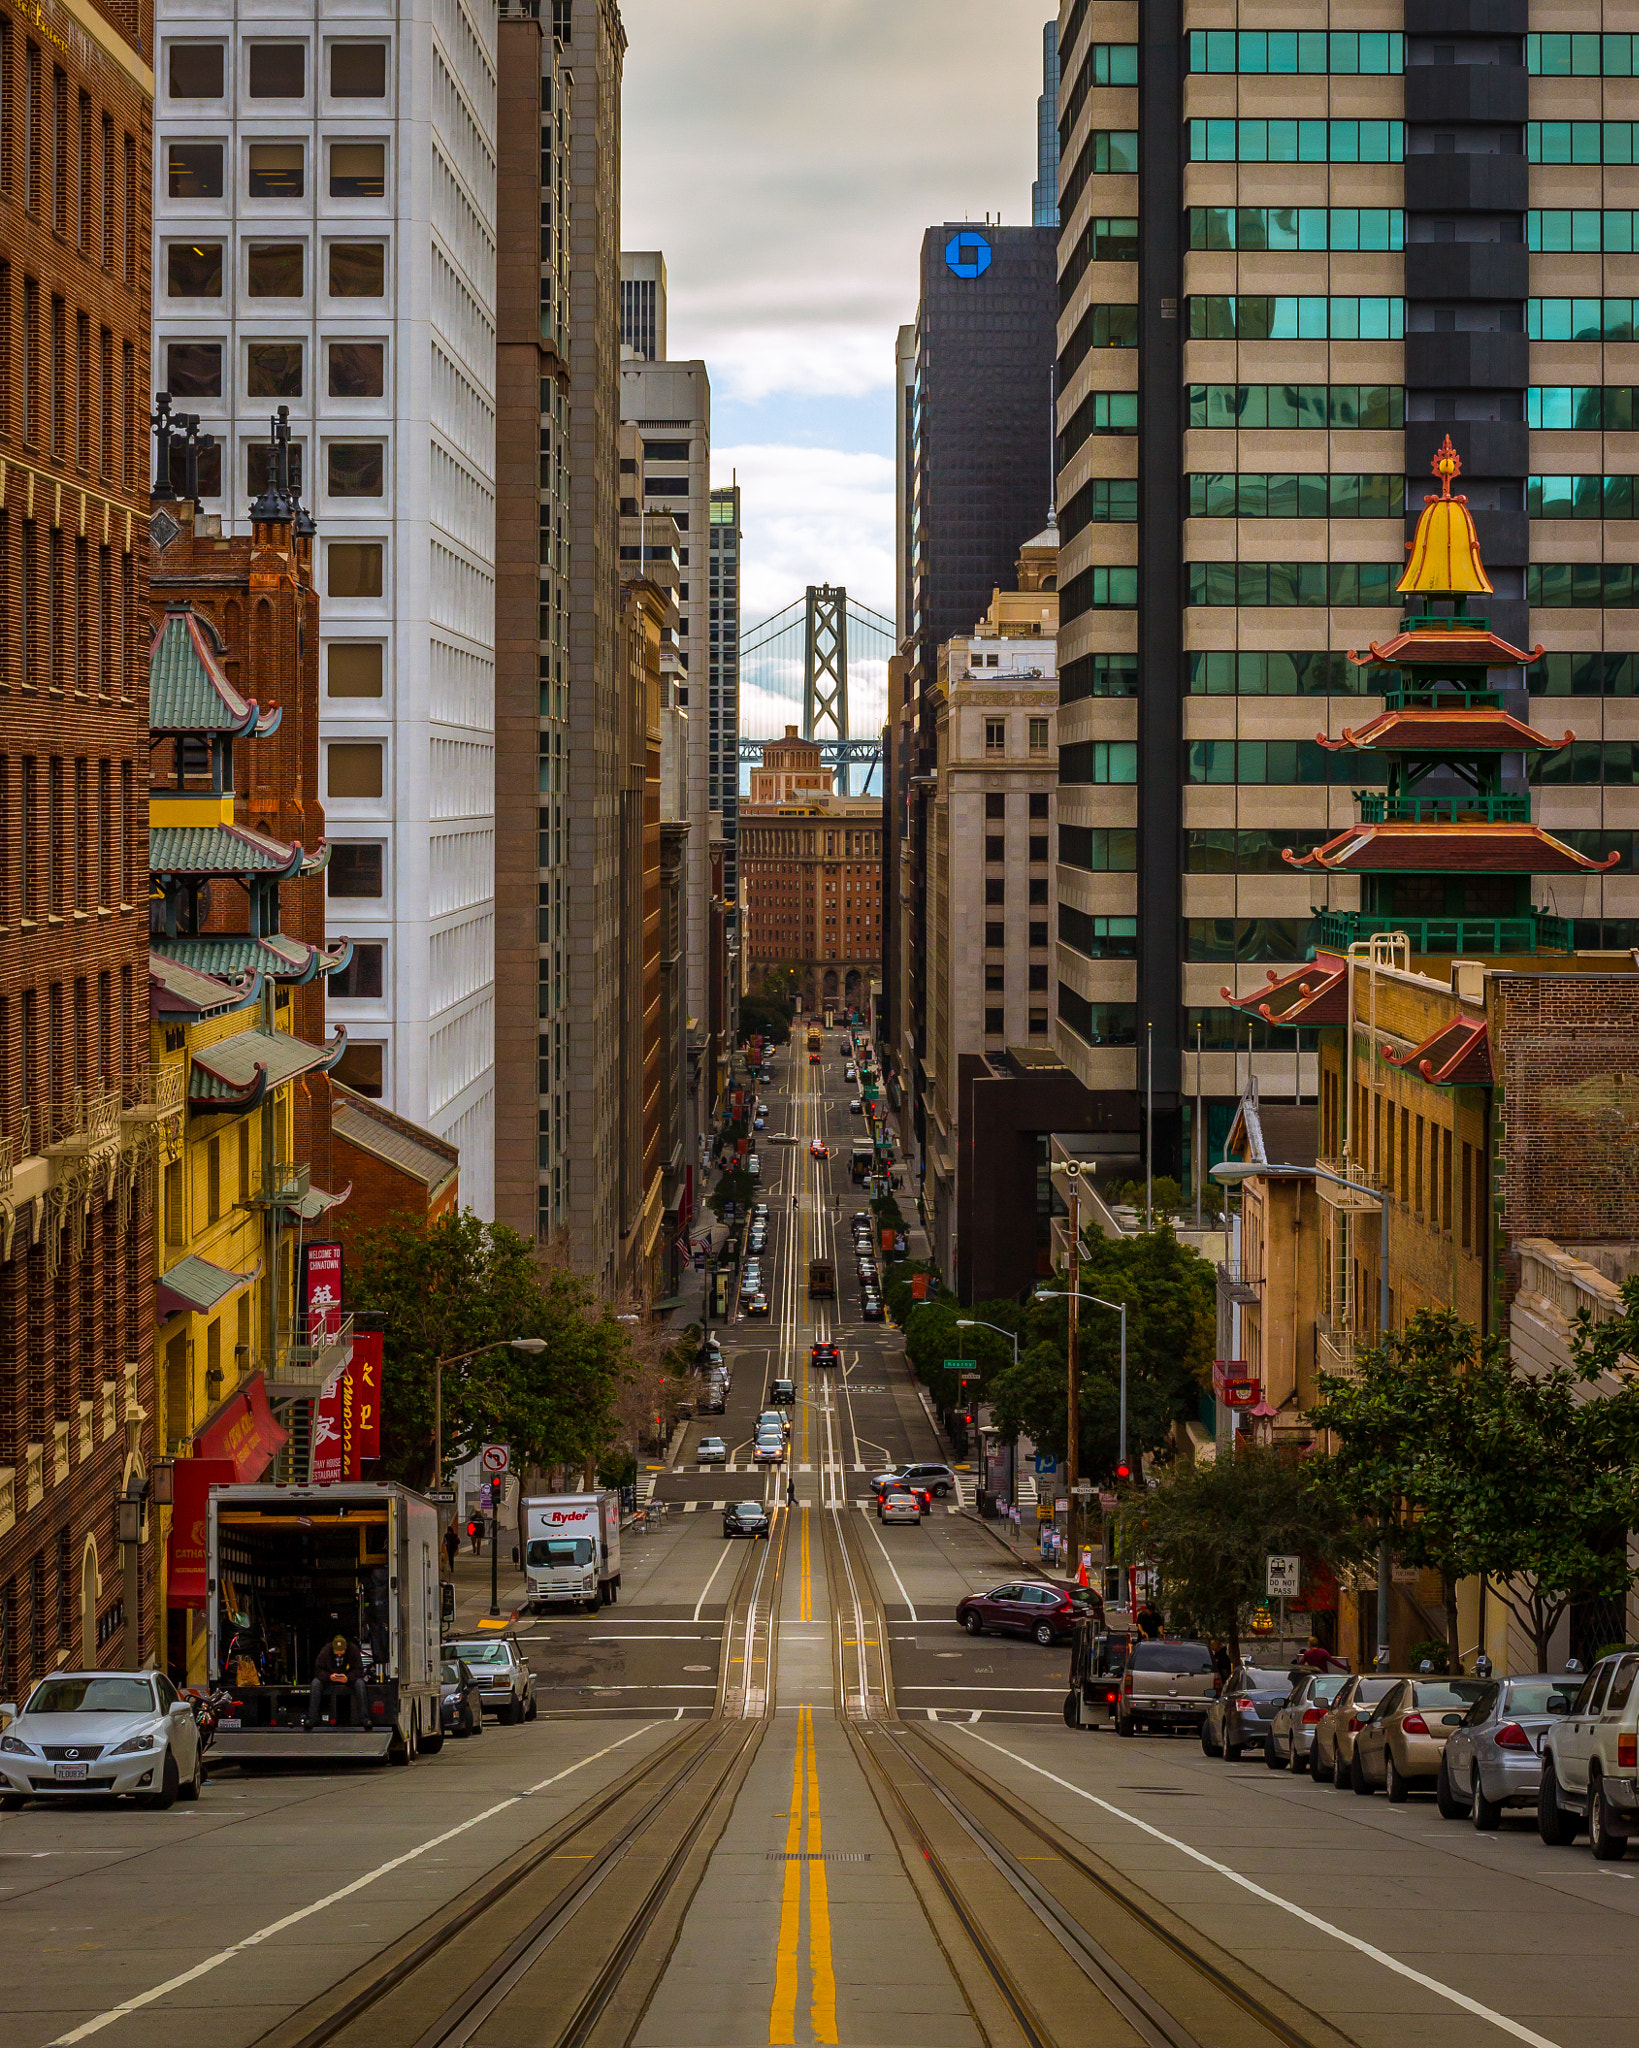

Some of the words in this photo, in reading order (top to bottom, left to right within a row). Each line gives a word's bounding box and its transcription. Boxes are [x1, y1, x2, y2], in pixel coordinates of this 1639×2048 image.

[308, 1249, 332, 1259] WELCOME
[333, 1248, 341, 1258] TO
[310, 1259, 339, 1271] CHINATOWN
[326, 1457, 341, 1467] HOUSE
[552, 1511, 588, 1524] Ryder
